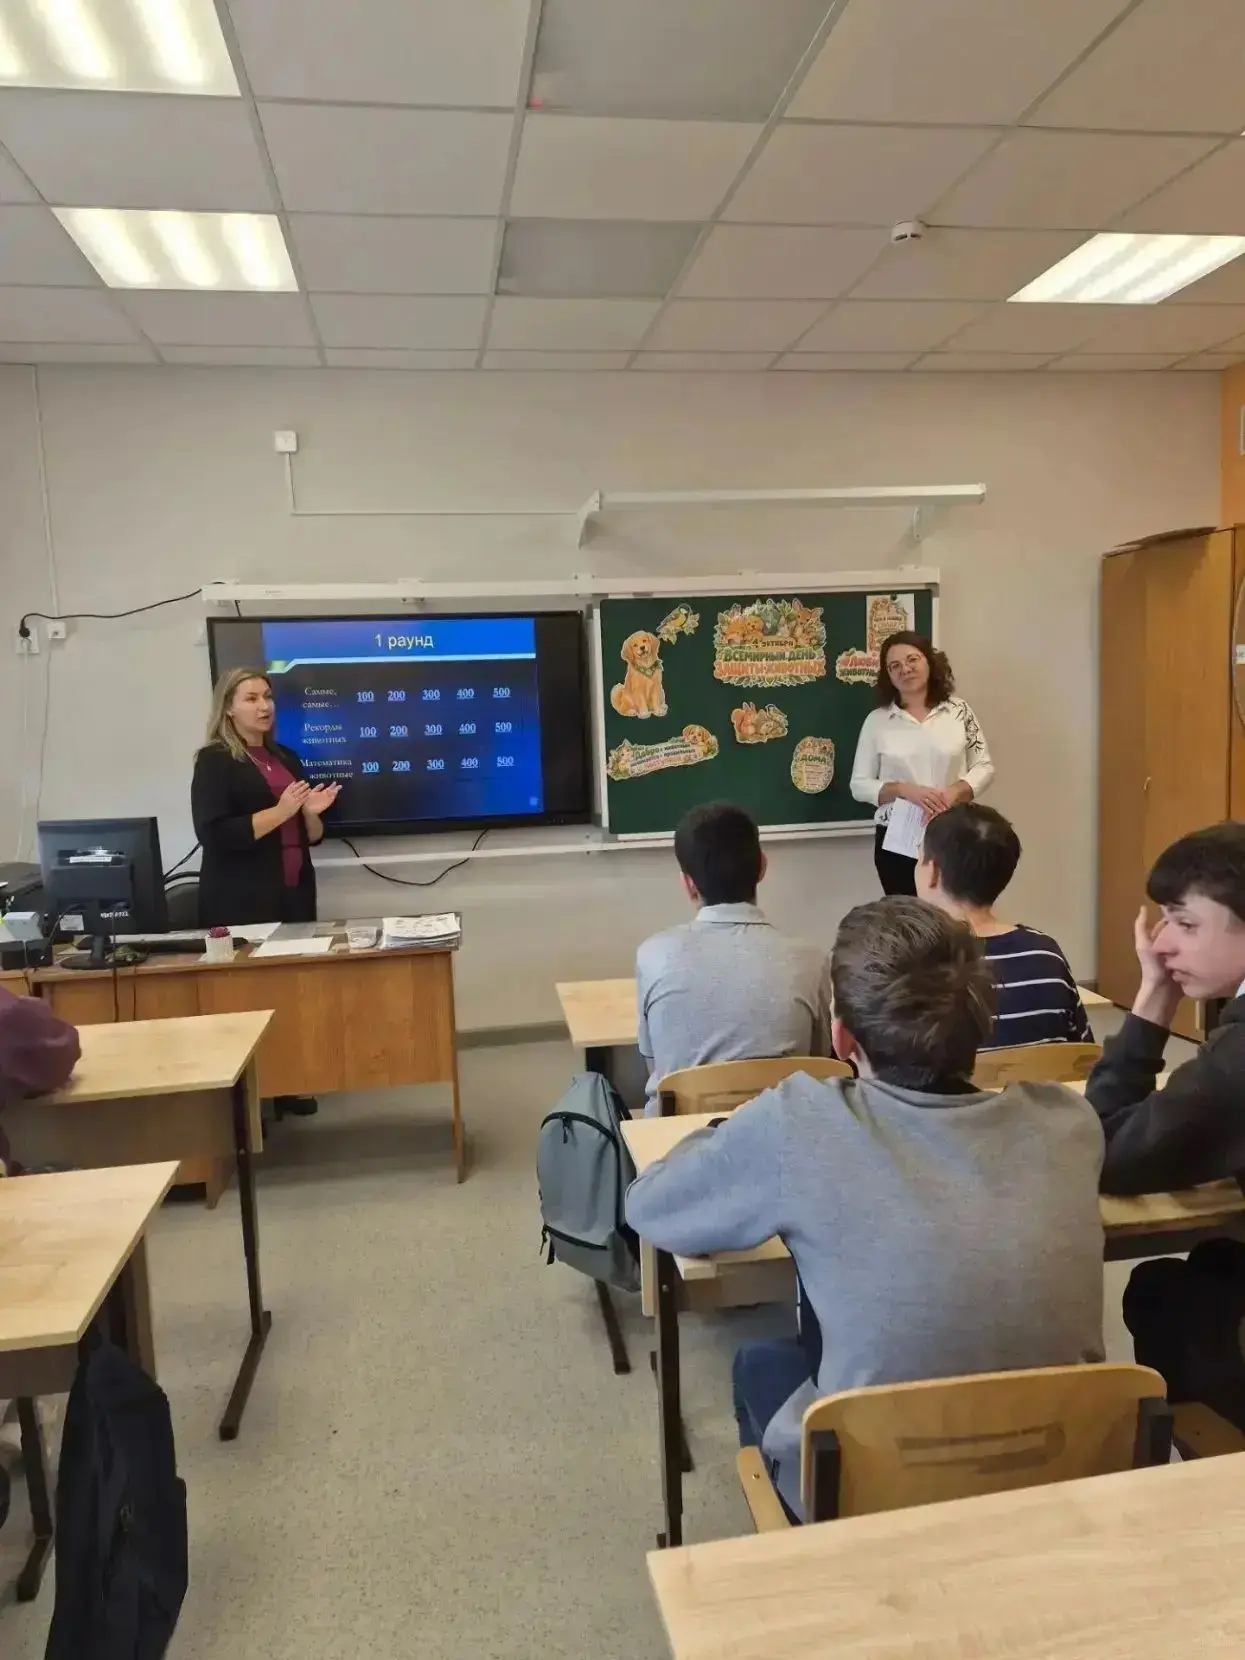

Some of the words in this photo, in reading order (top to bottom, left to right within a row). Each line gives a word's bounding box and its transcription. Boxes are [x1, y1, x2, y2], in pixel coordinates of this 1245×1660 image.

[374, 633, 382, 647] 1
[388, 635, 434, 650] раунд
[752, 638, 759, 648] 4
[724, 650, 785, 662] ВСЕМИРНЫЙ
[787, 650, 816, 661] ДЕНЬ
[357, 690, 375, 702] 100
[387, 690, 406, 702] 200
[422, 689, 441, 701] 300
[456, 688, 475, 700] 400
[493, 687, 511, 698] 500
[303, 722, 343, 734] Рекорды
[359, 726, 377, 738] 100
[389, 725, 408, 737] 200
[424, 724, 443, 736] 300
[459, 723, 477, 734] 400
[495, 721, 513, 732] 500
[361, 761, 380, 773] 100
[392, 760, 411, 772] 200
[426, 759, 445, 771] 300
[460, 757, 479, 769] 400
[496, 756, 515, 767] 500
[800, 754, 827, 763] ДОМА
